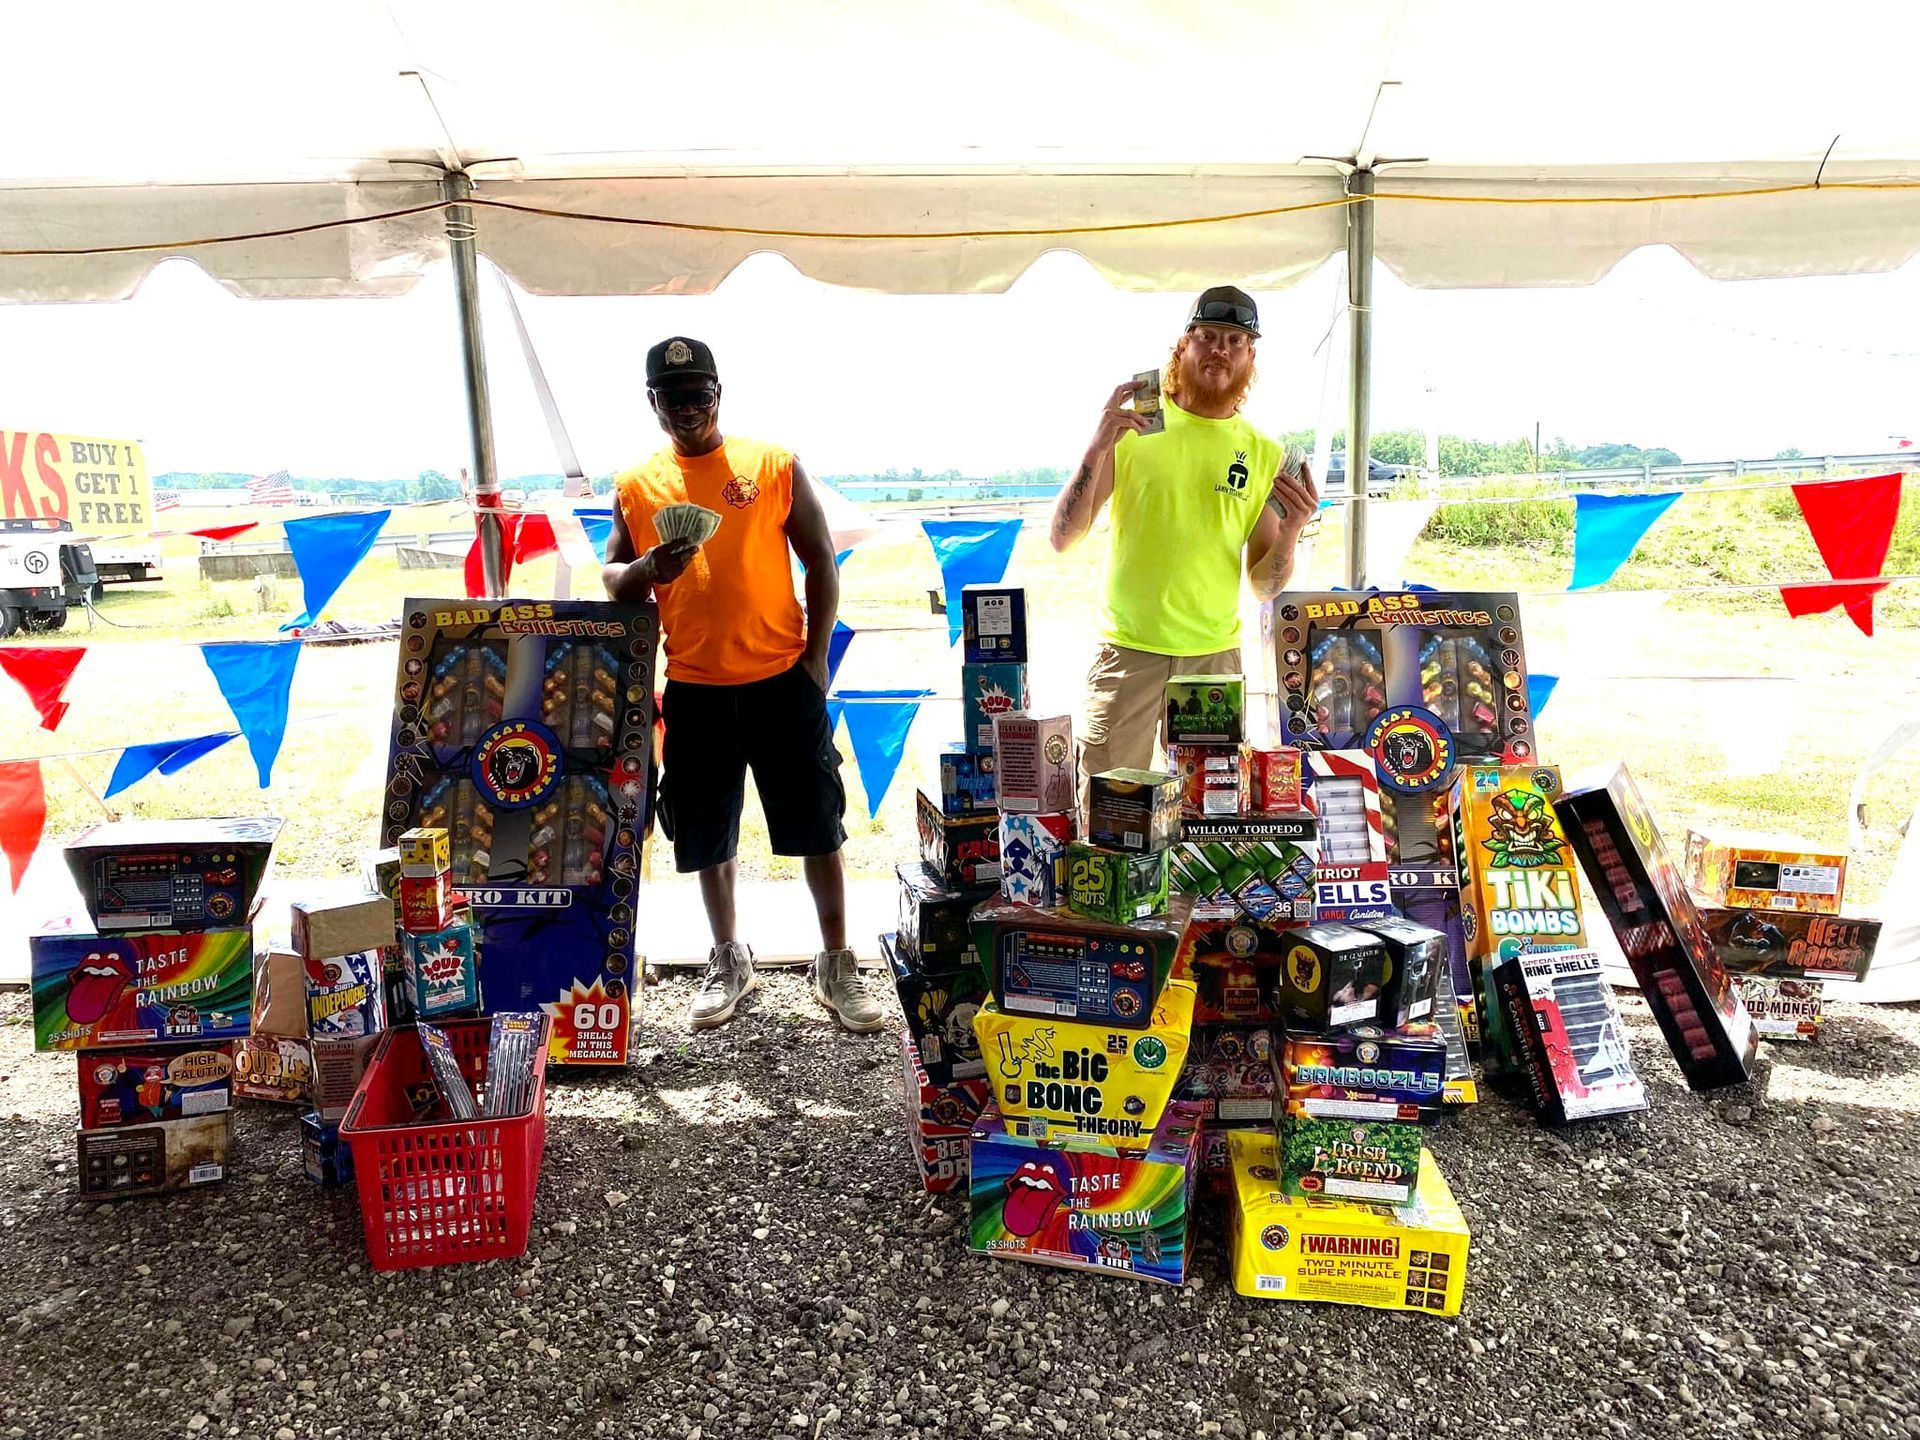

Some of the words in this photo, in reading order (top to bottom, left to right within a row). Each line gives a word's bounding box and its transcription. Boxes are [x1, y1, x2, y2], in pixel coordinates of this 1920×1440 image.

[70, 441, 117, 466] BUY
[124, 445, 134, 466] 1
[75, 472, 120, 495] GET
[129, 475, 138, 495] 1
[79, 501, 143, 524] FREE
[434, 608, 491, 627] BAD
[499, 603, 553, 622] ASS
[1305, 601, 1360, 619] BAD
[1368, 594, 1419, 612] ASS
[980, 695, 1012, 709] LOUD
[1371, 710, 1413, 748] GREAT
[478, 723, 526, 762] GREAT
[1395, 738, 1449, 788] GRIZZLY
[495, 753, 558, 803] GRIZZLY
[1474, 770, 1500, 787] 24
[1187, 825, 1239, 835] WILLOW
[1243, 825, 1304, 835] TORPEDO
[1073, 857, 1106, 892] 25
[515, 890, 567, 904] KIT
[1073, 891, 1106, 907] SHOTS
[1318, 882, 1387, 905] ELLS
[1274, 901, 1292, 913] 36
[1491, 910, 1580, 935] BOMBS
[136, 949, 188, 973] TASTE
[424, 957, 461, 975] LOUD
[1522, 956, 1558, 967] SPECIAL
[1560, 952, 1598, 963] EFFECTS
[1524, 964, 1553, 978] RING
[1555, 960, 1601, 974] SHELLS
[136, 975, 158, 988] THE
[136, 974, 220, 1008] RAINBOW
[311, 984, 369, 1021] INDEPENDENCE
[1770, 1002, 1818, 1016] MONEY
[574, 1003, 621, 1030] 60
[48, 1032, 60, 1044] 25
[62, 1027, 91, 1041] SHOTS
[577, 1031, 613, 1040] SHELLS
[577, 1041, 587, 1049] IN
[590, 1041, 612, 1049] THIS
[1107, 1034, 1129, 1048] 25
[185, 1055, 217, 1067] HIGH
[568, 1050, 619, 1059] MEGAPACK
[1508, 999, 1531, 1062] CANISTER
[1527, 1063, 1545, 1109] SHELLS
[235, 1072, 295, 1089] DOWN
[1035, 1062, 1061, 1079] the
[1297, 1064, 1440, 1092] BAMBOOZLE
[1027, 1081, 1104, 1116] BONG
[1074, 1116, 1143, 1139] THEORY
[1331, 1140, 1387, 1161] IRISH
[1312, 1146, 1402, 1179] LEGEND
[1069, 1173, 1121, 1193] TASTE
[1069, 1198, 1090, 1209] THE
[1068, 1209, 1152, 1231] RAINBOW
[985, 1239, 997, 1250] 25
[998, 1239, 1026, 1250] SHOTS
[1308, 1236, 1393, 1257] WARNING
[1297, 1267, 1346, 1277] SUPER
[1351, 1269, 1402, 1279] FINALE
[1304, 1259, 1335, 1268] TWO
[1340, 1260, 1395, 1270] MINUTE
